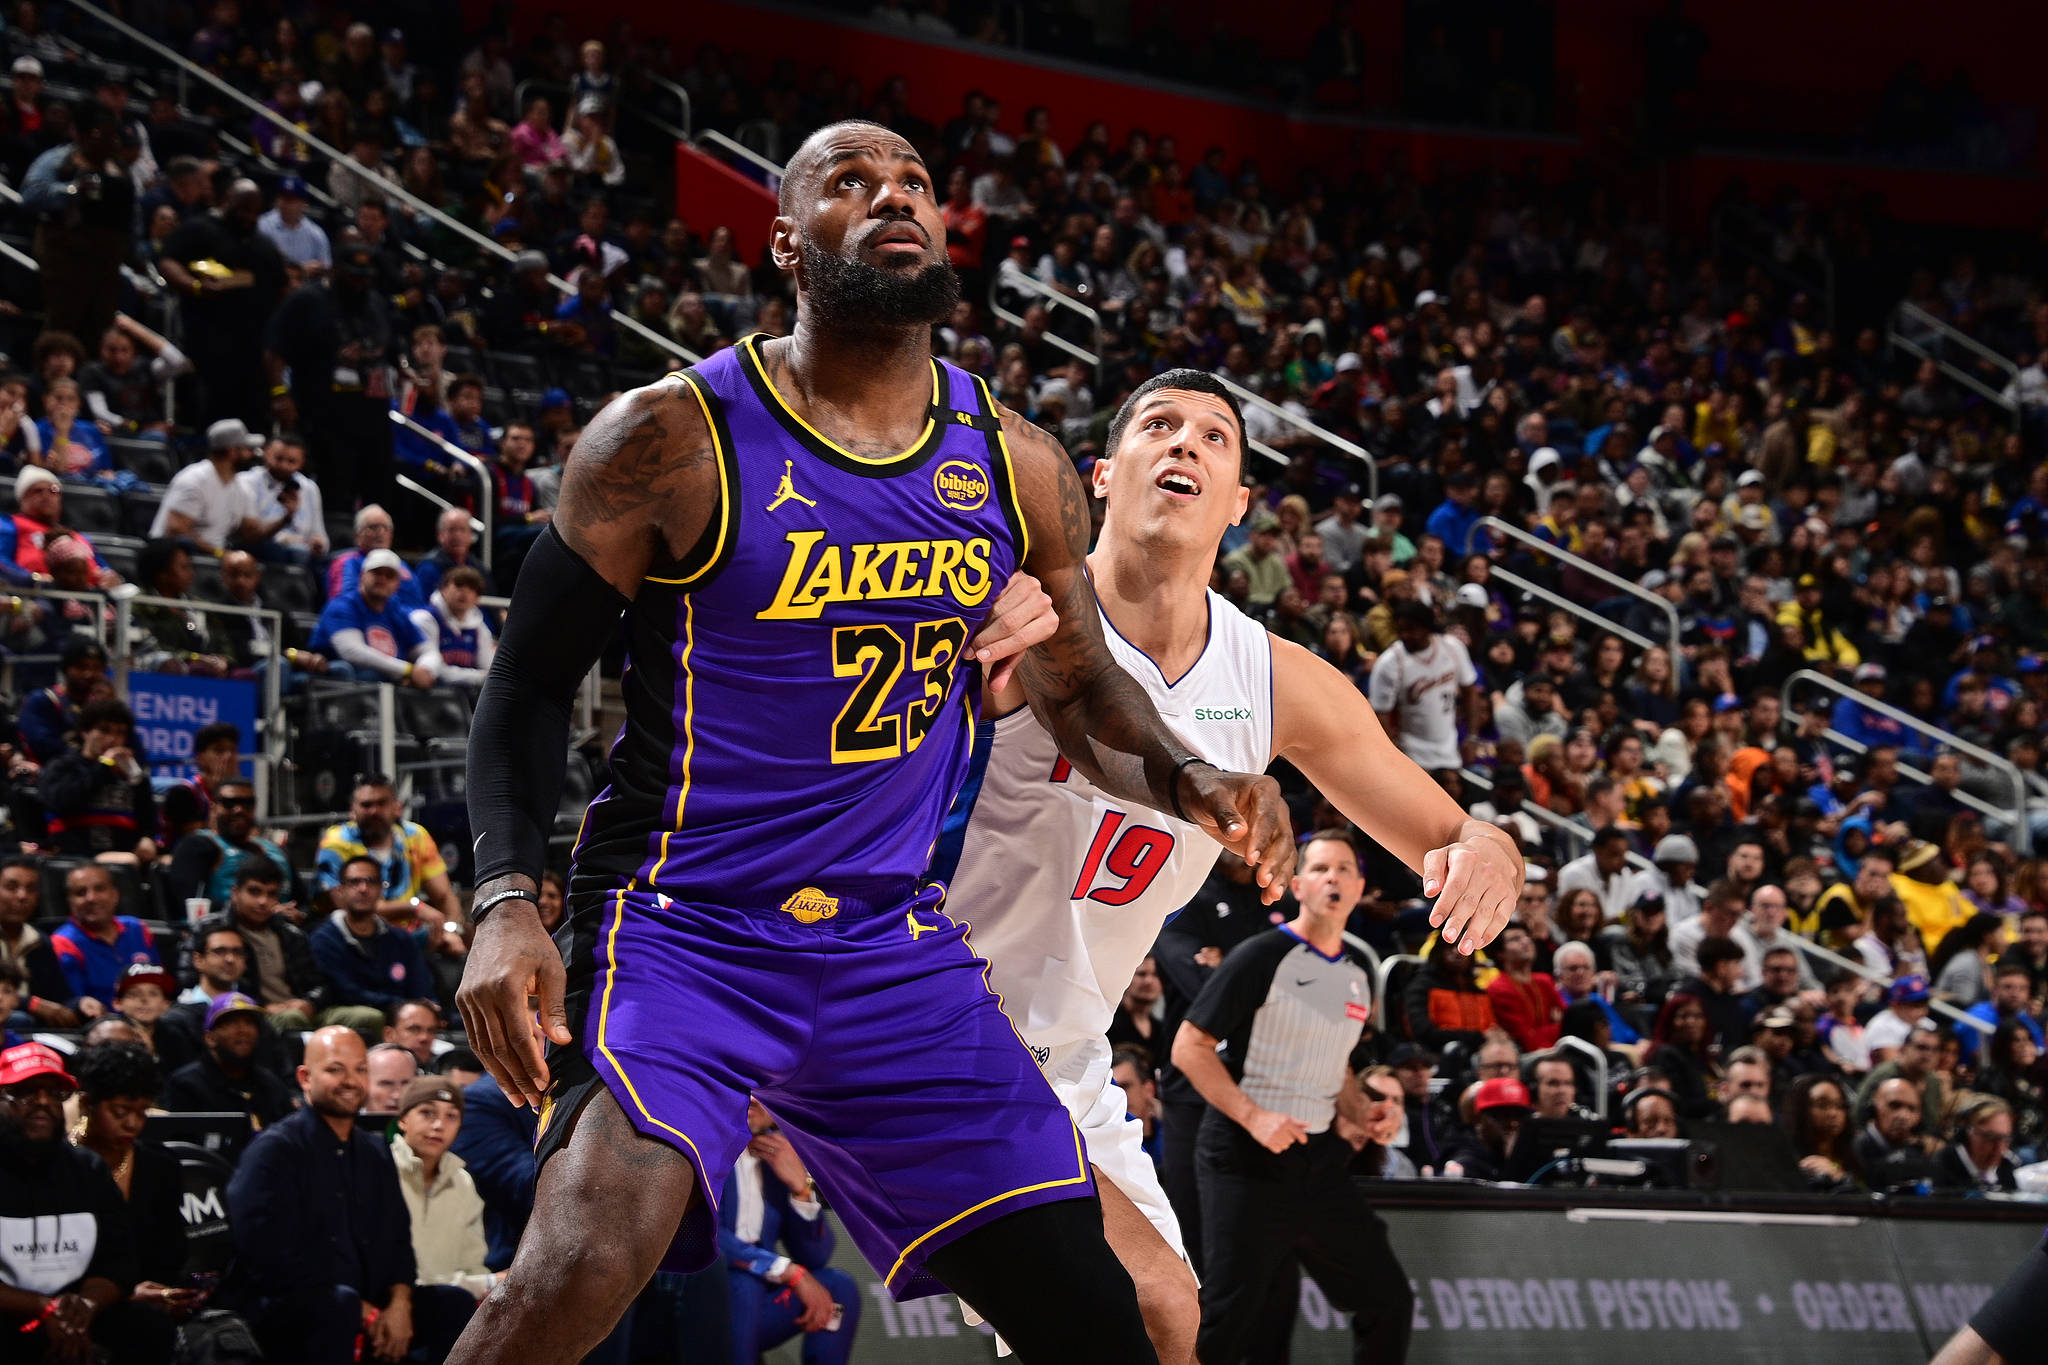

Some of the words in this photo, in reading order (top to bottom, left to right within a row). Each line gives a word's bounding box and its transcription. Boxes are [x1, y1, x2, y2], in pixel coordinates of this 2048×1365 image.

[956, 411, 973, 427] 44
[939, 472, 986, 499] bibigo
[754, 529, 993, 621] LAKERS
[130, 691, 218, 725] ENRY
[831, 616, 969, 765] 23
[1194, 707, 1253, 721] StockX
[1070, 809, 1175, 907] 19
[786, 894, 835, 917] LAKERS
[1430, 1278, 1588, 1331] DETROIT
[1587, 1278, 1741, 1331] PISTONS
[1792, 1280, 1916, 1332] ORDER
